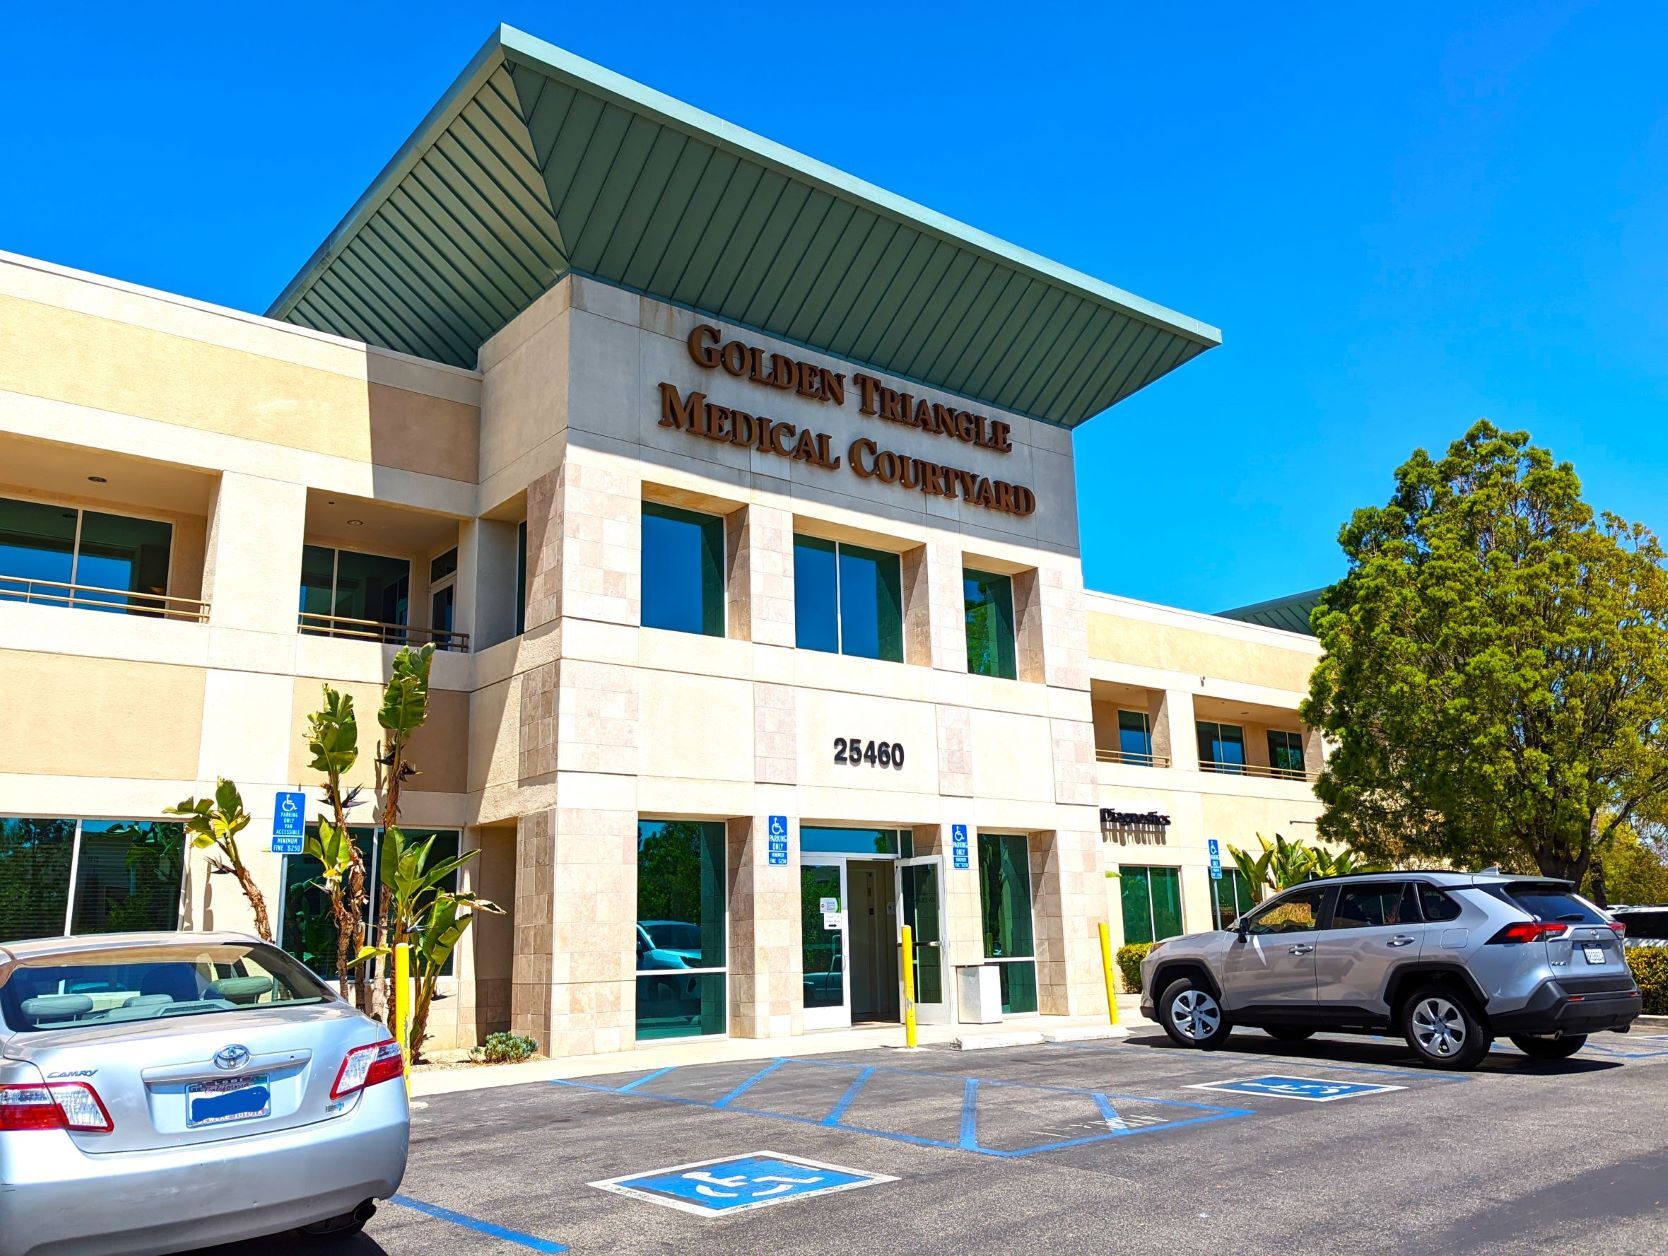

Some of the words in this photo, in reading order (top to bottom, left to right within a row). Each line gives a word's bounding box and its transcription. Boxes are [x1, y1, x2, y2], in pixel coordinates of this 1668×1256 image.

[688, 324, 847, 406] GOLDEN
[853, 372, 1013, 453] TRIANGLE
[657, 382, 841, 470] MEDICAL
[848, 437, 1036, 516] COURTYARD
[833, 737, 905, 768] 25460
[47, 1069, 99, 1078] CAMRY
